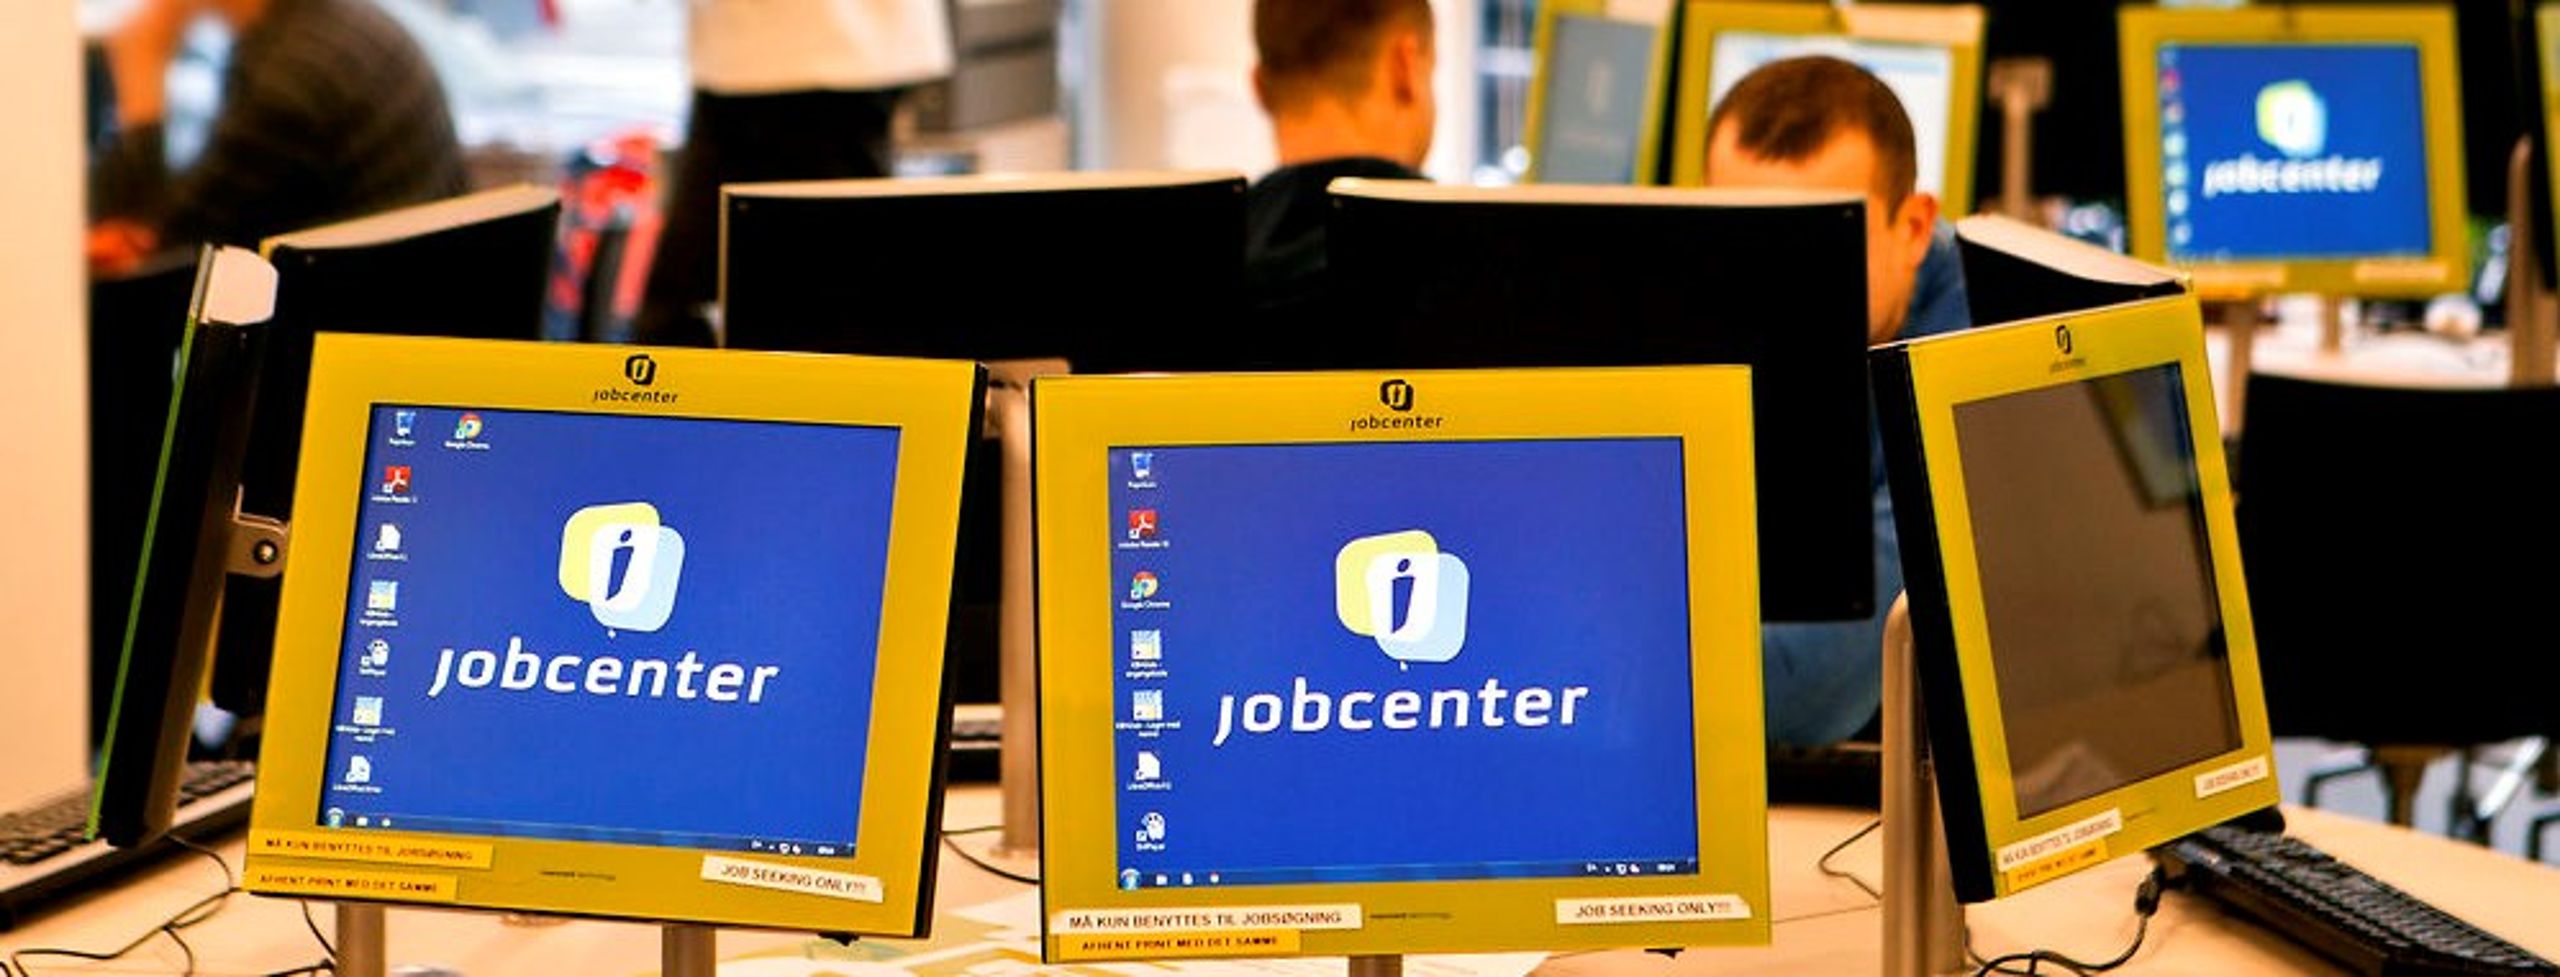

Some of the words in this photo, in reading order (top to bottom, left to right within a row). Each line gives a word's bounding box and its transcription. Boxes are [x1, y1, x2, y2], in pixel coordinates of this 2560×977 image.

[2203, 153, 2382, 199] jobcenter
[592, 387, 679, 404] jobcenter
[1350, 414, 1444, 432] jobcenter
[427, 635, 780, 704] jobcenter
[1212, 676, 1590, 747] jobcenter
[721, 864, 749, 879] JOB
[753, 868, 812, 888] SEEKING
[1069, 913, 1093, 928] MÅ
[1097, 915, 1129, 928] KUN
[1134, 914, 1211, 928] BENYTTES
[1217, 913, 1235, 926] TIL
[1241, 911, 1342, 927] JOBSØGNING
[1576, 903, 1606, 918] JOB
[1610, 902, 1674, 918] SEEKING
